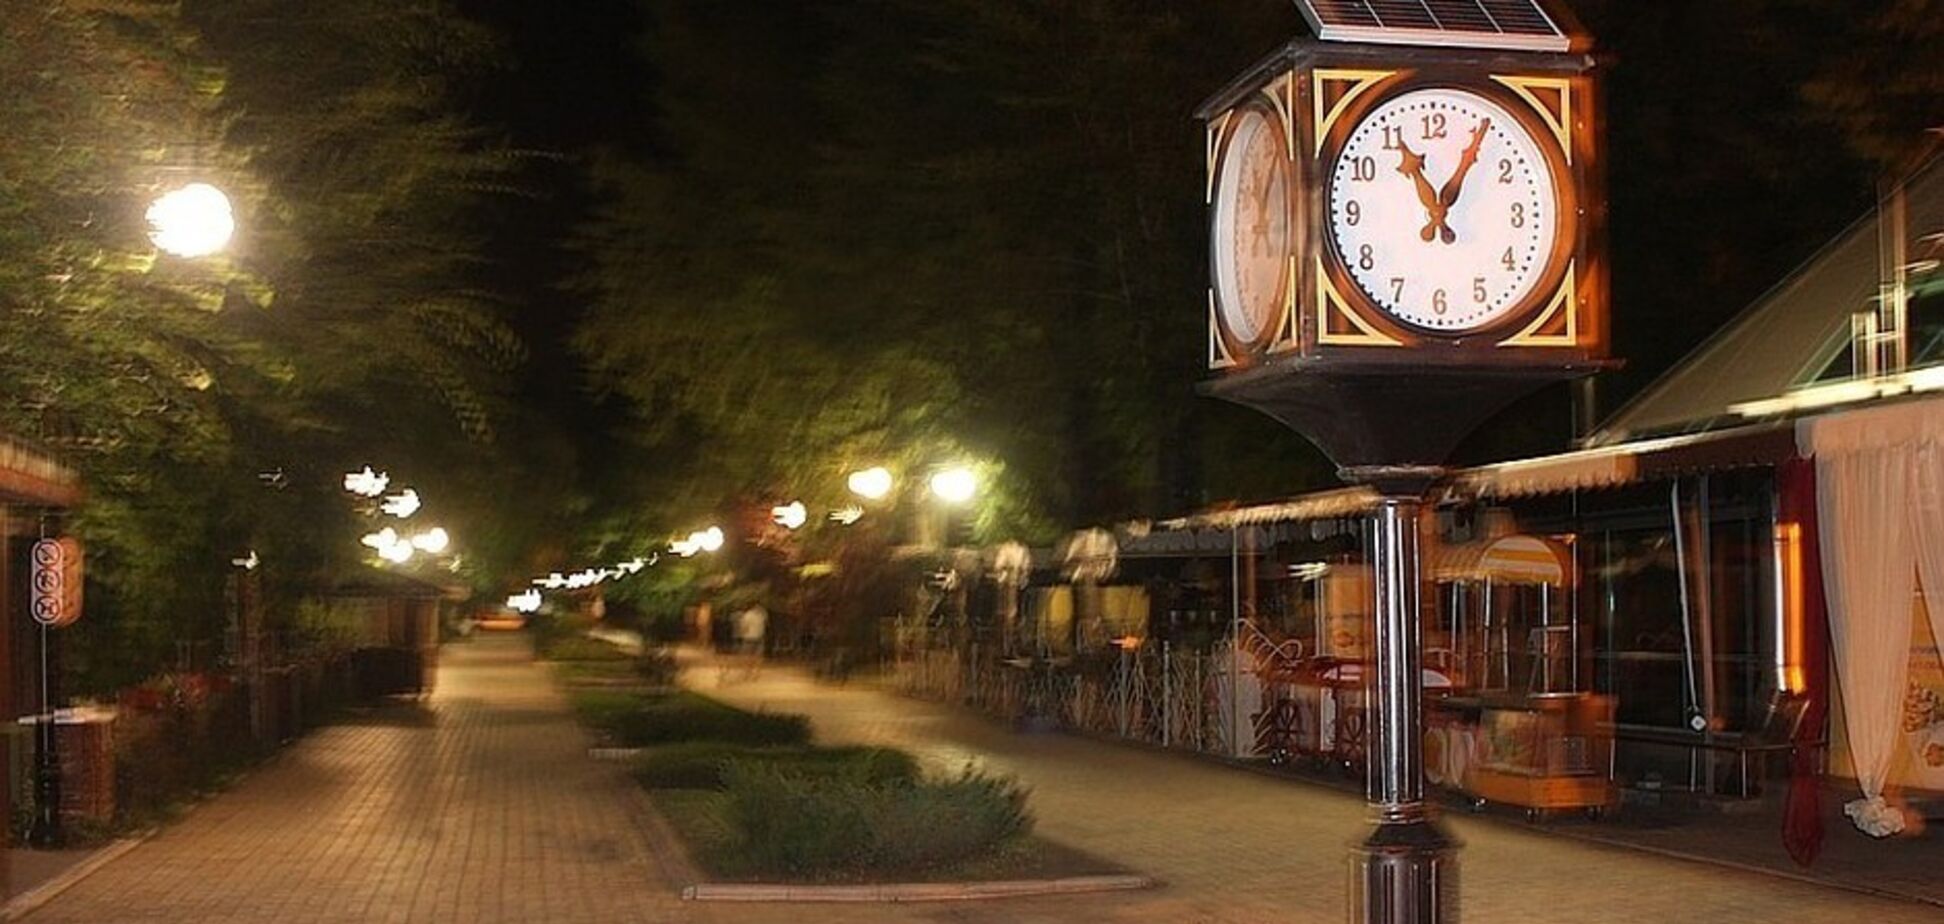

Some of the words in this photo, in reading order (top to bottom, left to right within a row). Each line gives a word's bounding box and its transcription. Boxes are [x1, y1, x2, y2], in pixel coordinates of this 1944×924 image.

[1381, 126, 1401, 150] 11
[1421, 113, 1447, 140] 12
[1351, 157, 1376, 181] 10
[1498, 159, 1513, 183] 2
[1345, 201, 1361, 226] 9
[1510, 203, 1525, 228] 3
[1359, 244, 1374, 271] 8
[1501, 247, 1516, 271] 4
[1390, 278, 1405, 302] 7
[1432, 289, 1447, 314] 6
[1473, 278, 1488, 302] 5
